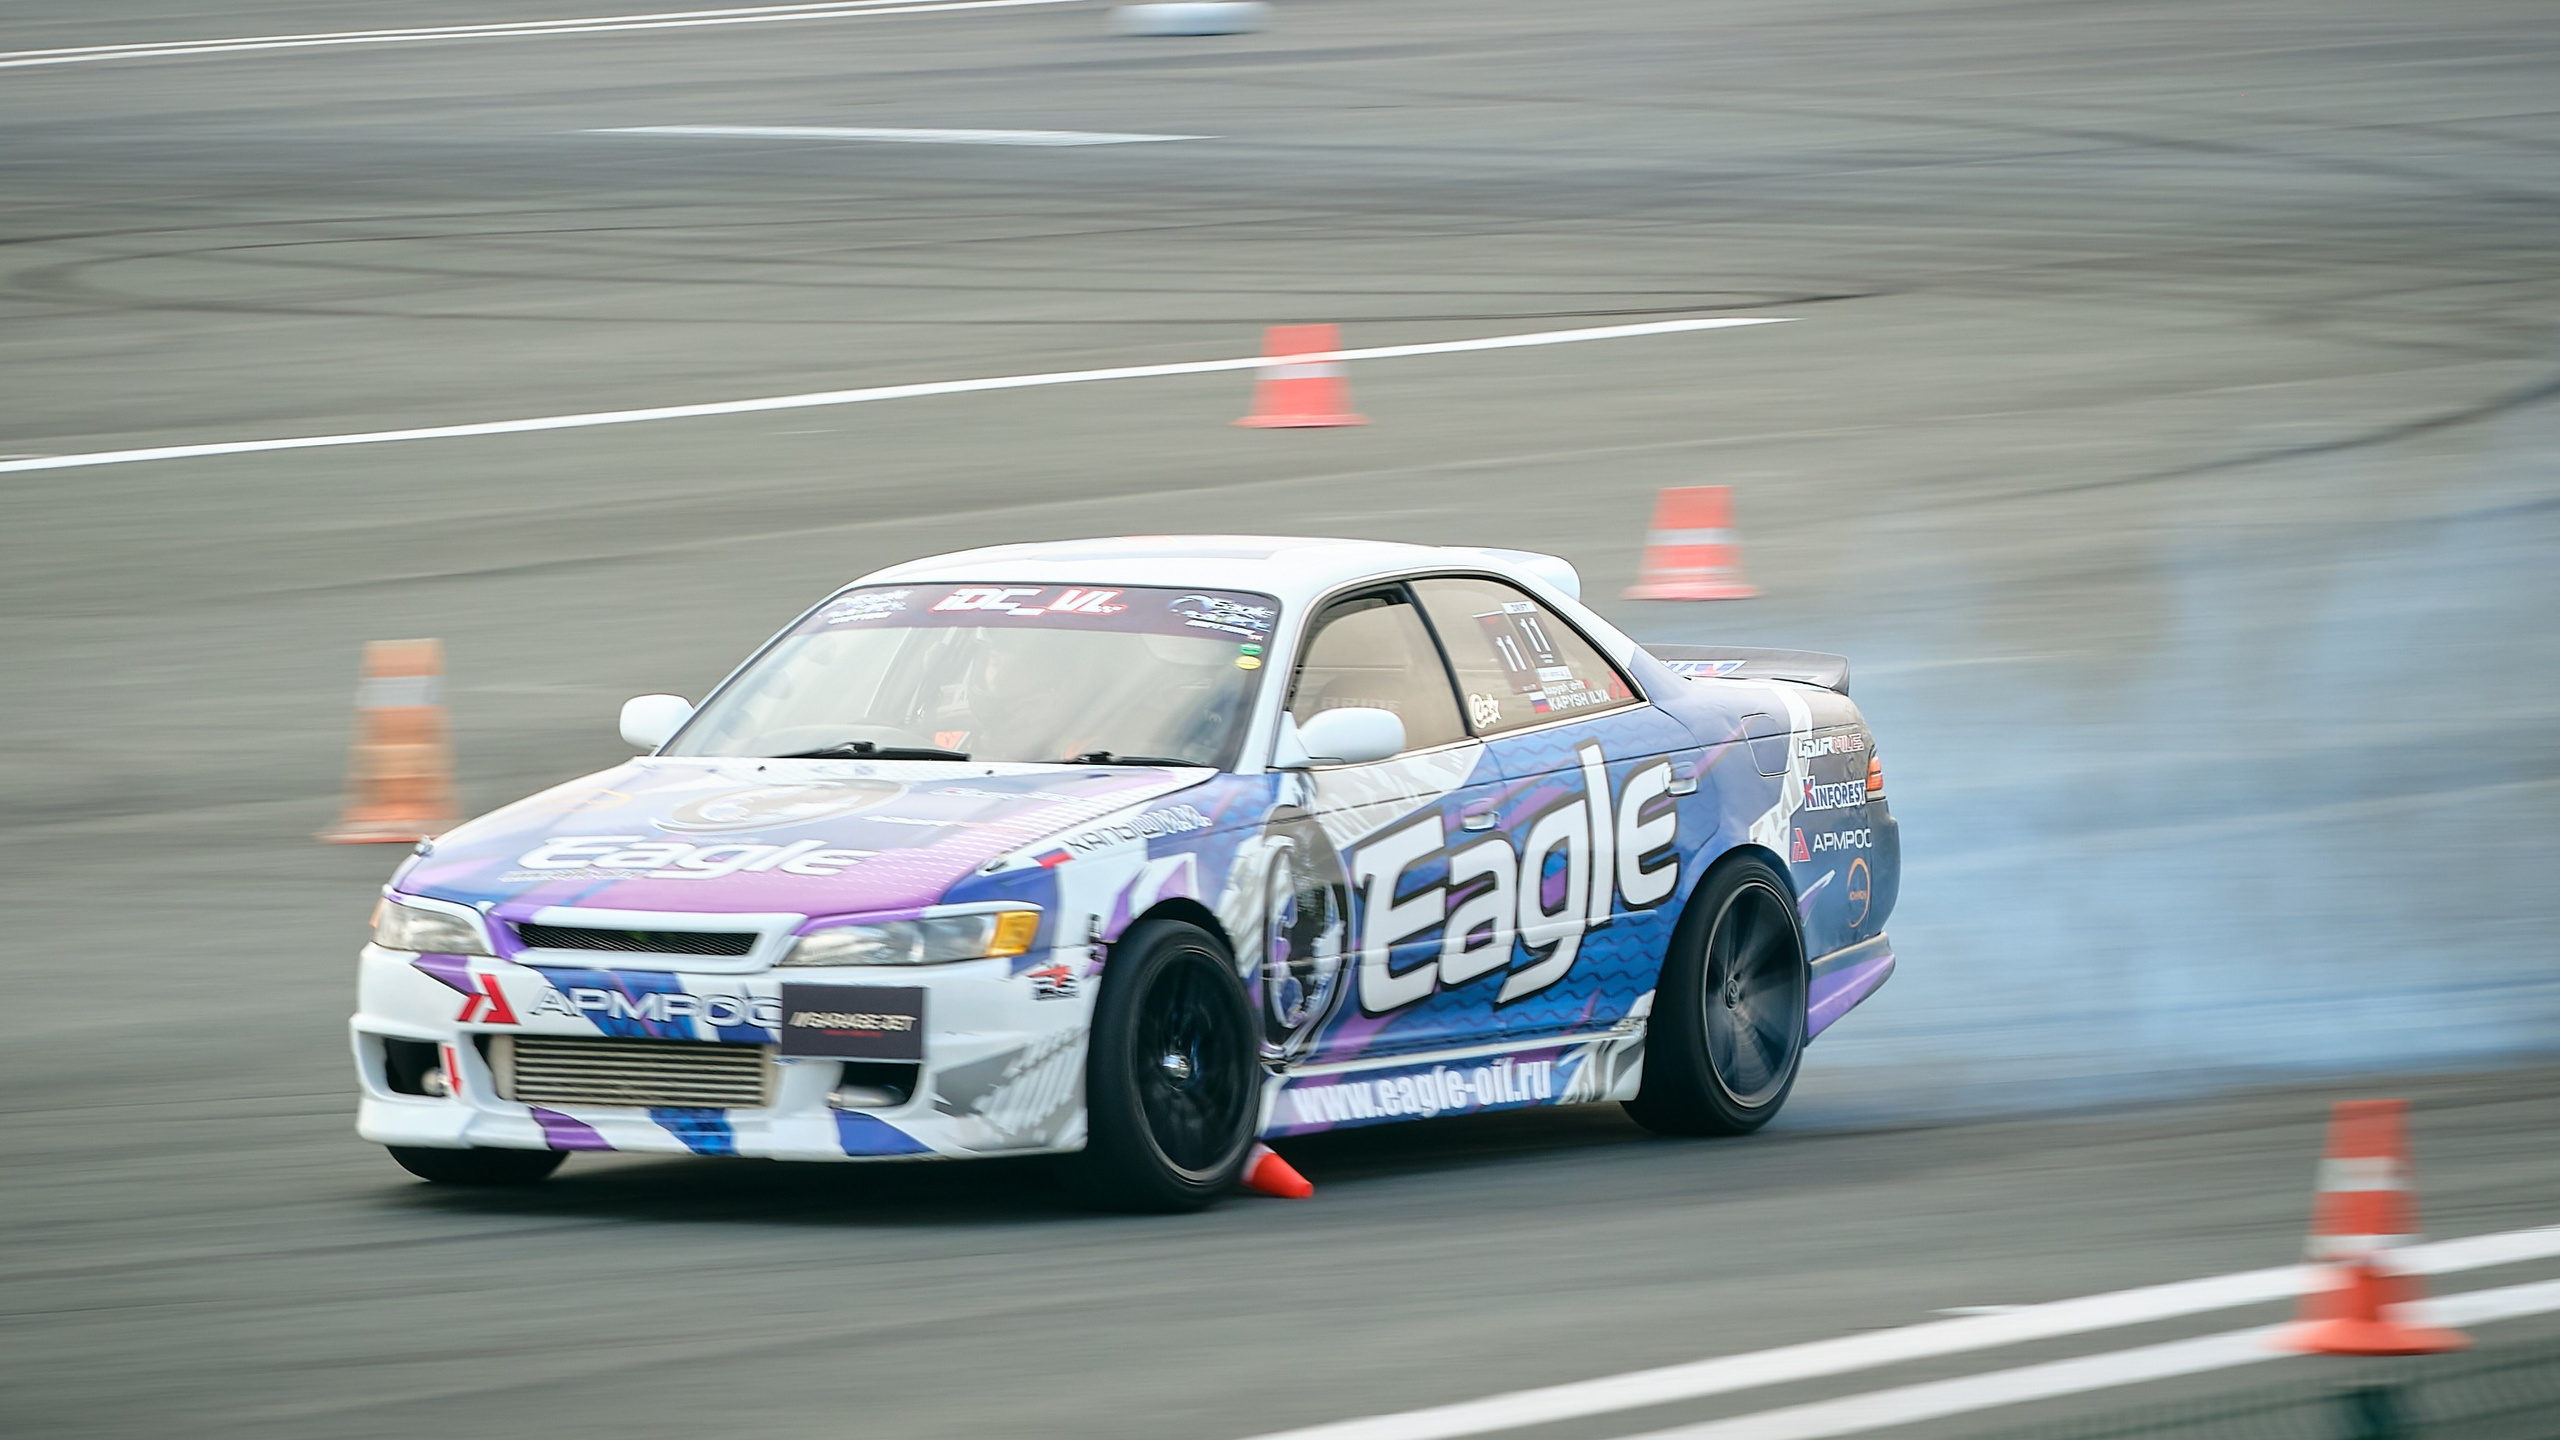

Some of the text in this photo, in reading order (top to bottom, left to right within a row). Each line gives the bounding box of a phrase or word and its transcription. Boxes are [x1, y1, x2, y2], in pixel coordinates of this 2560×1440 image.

[1519, 616, 1551, 652] 11
[1496, 635, 1527, 672] 11
[1548, 689, 1612, 711] KAPYSH ILYA
[1802, 777, 1866, 810] KINFOREST
[517, 835, 882, 880] Eagle
[1352, 743, 1680, 1013] Eagle
[1291, 1057, 1553, 1124] www.eagle-oil.ru
